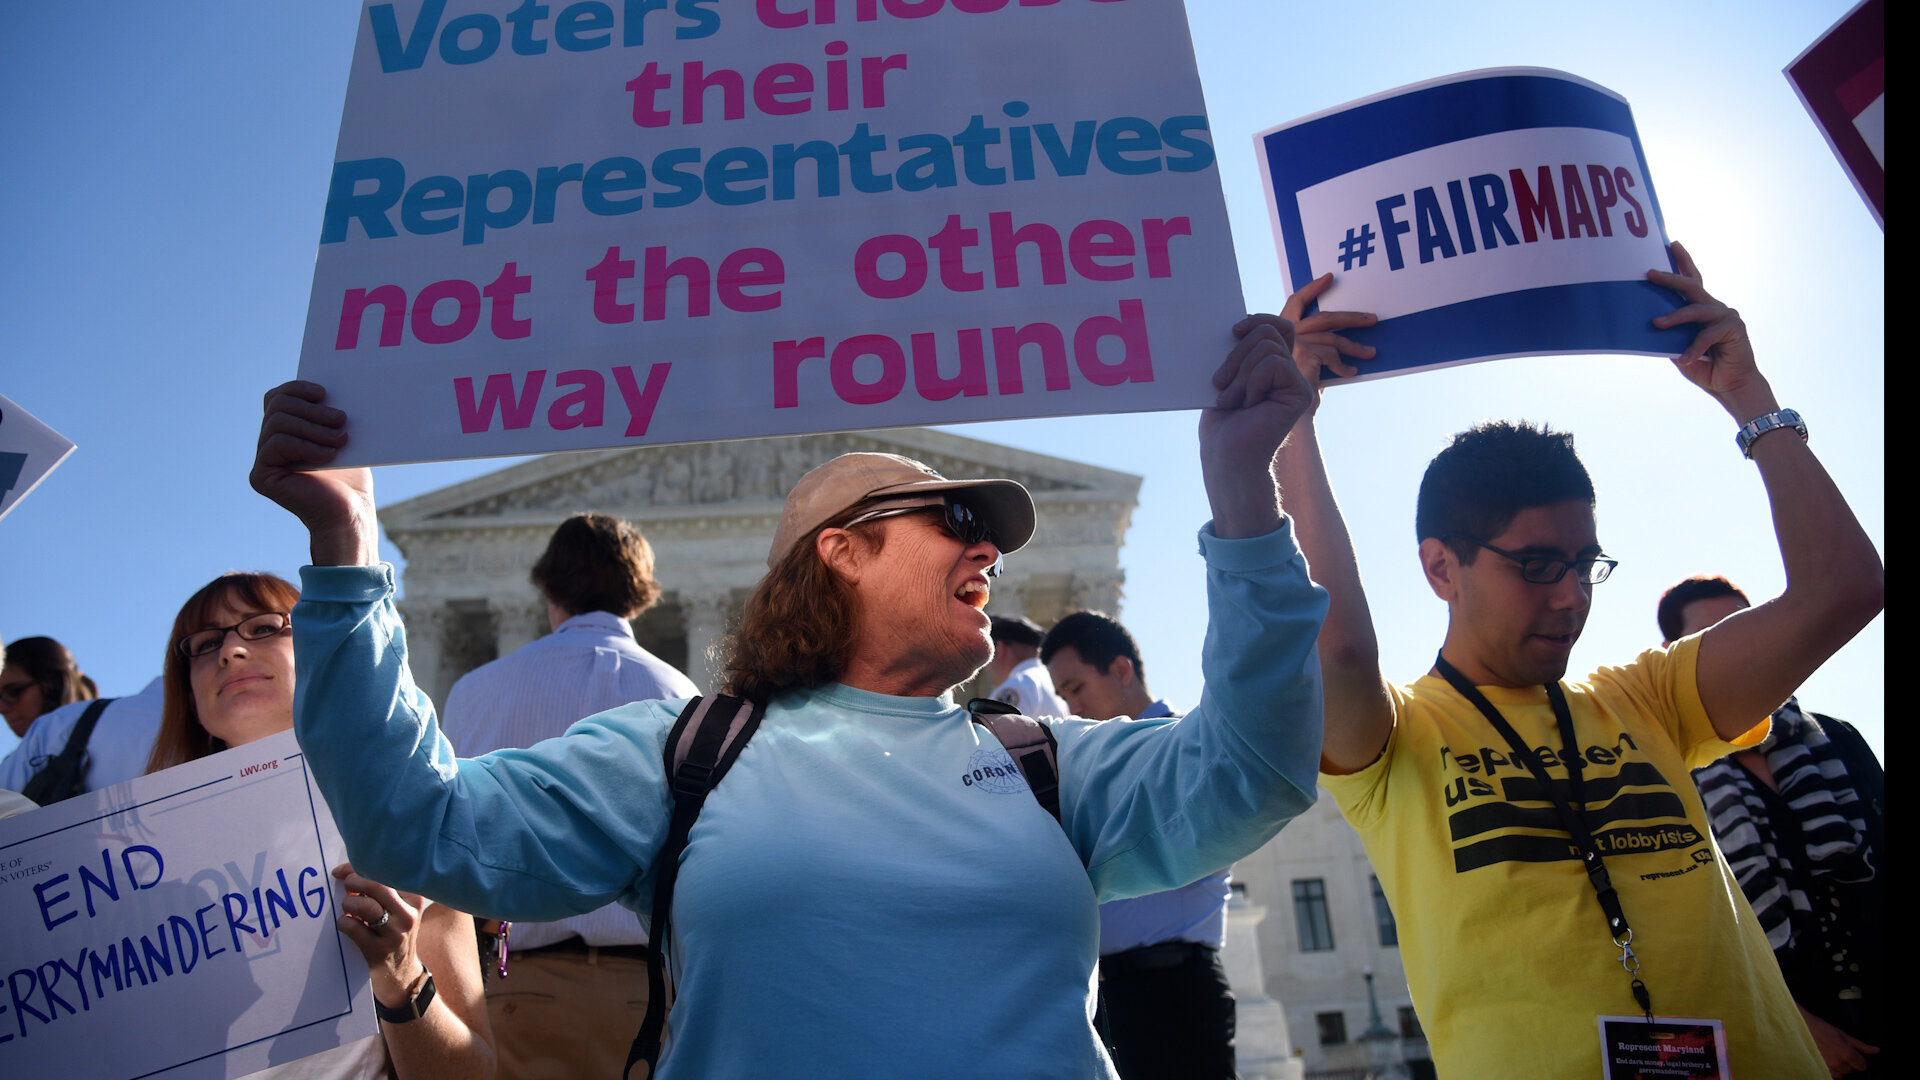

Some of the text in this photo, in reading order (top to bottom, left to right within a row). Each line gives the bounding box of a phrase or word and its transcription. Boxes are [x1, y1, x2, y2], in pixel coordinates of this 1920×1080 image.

[368, 0, 721, 74] Voters
[625, 40, 908, 128] their
[321, 100, 1215, 246] Representatives
[1337, 164, 1650, 272] #FAIRMAPS
[335, 211, 1193, 350] not the other
[453, 298, 1155, 437] way round
[239, 760, 279, 778] LWV.org
[1444, 776, 1497, 808] us
[1568, 829, 1698, 857] nt lobbyists
[33, 844, 165, 932] END
[1617, 1042, 1706, 1056] Represent Maryland
